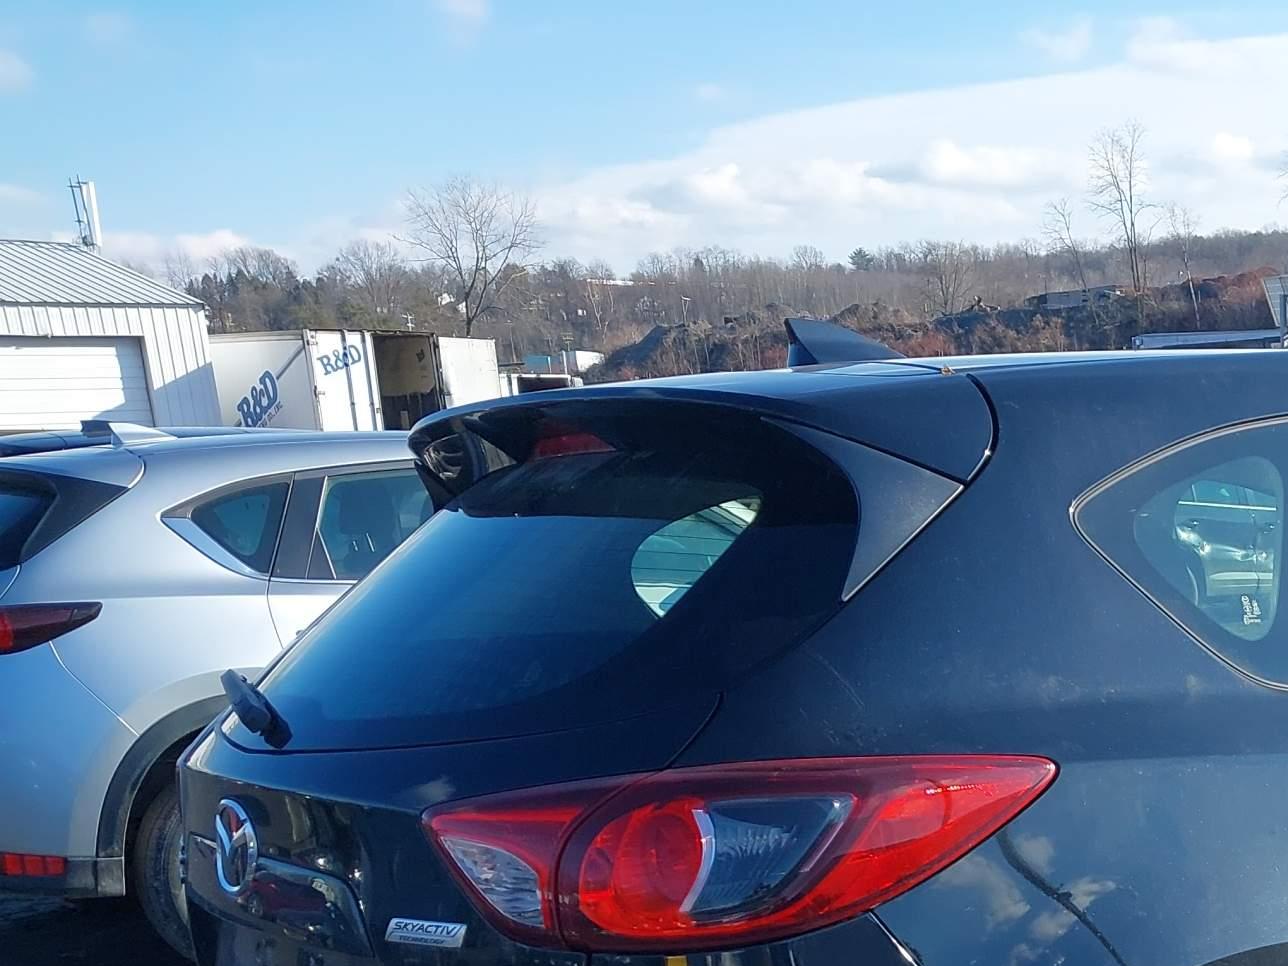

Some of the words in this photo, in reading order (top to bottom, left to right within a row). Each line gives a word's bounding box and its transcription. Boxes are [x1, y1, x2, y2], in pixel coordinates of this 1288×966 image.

[316, 344, 362, 376] R&D
[237, 369, 278, 428] R&D
[393, 920, 457, 936] SKYACTIV
